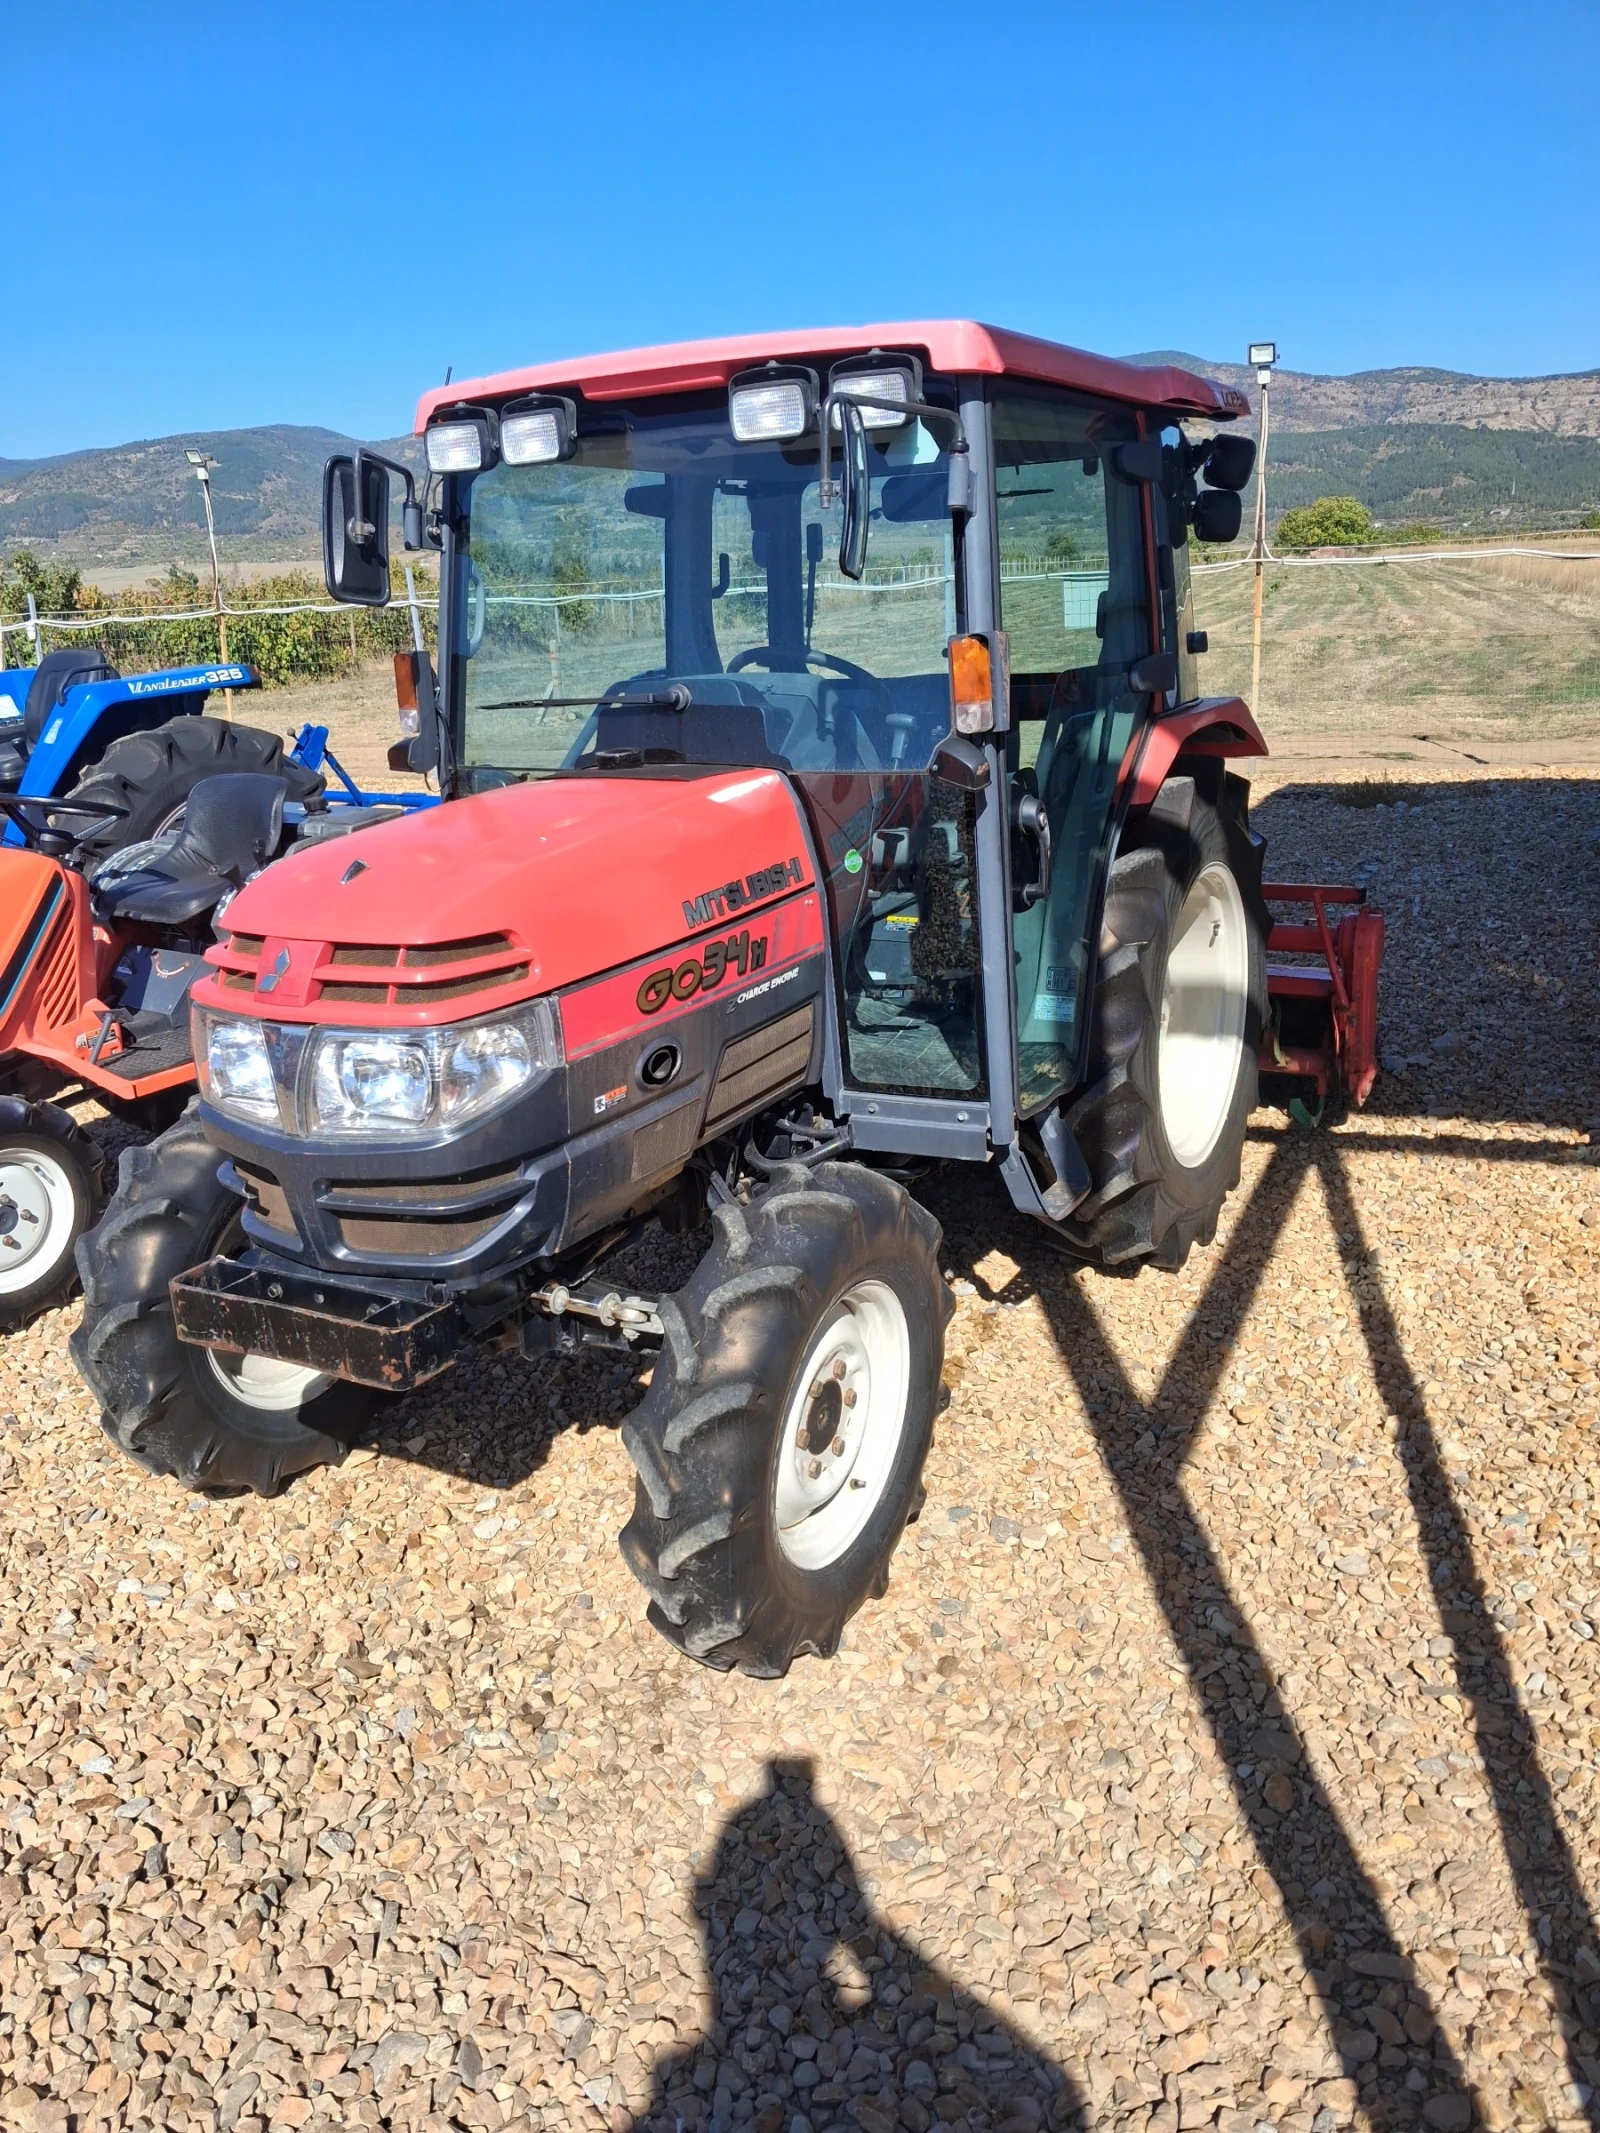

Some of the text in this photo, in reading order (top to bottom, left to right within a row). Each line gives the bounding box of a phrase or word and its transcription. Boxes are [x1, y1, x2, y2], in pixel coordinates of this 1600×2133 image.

[205, 667, 243, 683] 325
[682, 856, 805, 929] MITSUBISHI
[737, 981, 771, 1003] CHARGE
[770, 967, 800, 989] ENGINE
